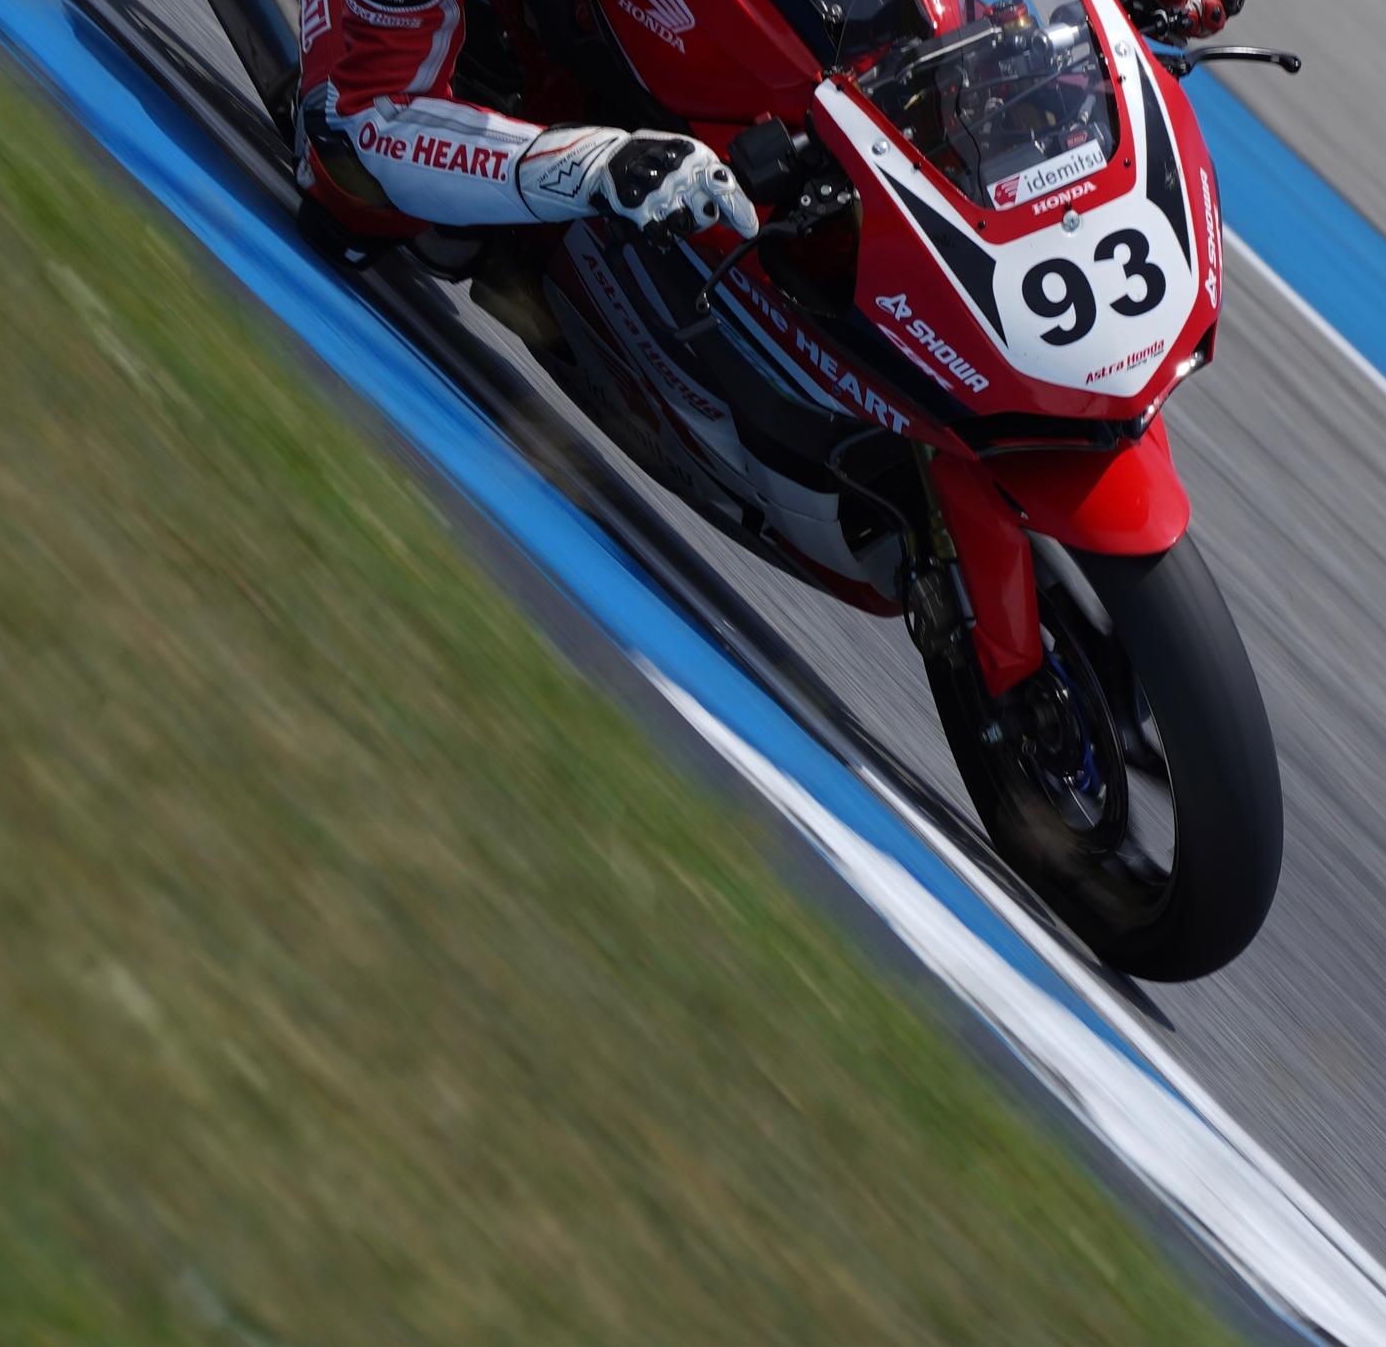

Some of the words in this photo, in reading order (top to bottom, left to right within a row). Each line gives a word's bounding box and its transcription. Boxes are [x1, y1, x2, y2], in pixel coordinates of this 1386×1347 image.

[359, 122, 407, 160] One
[411, 134, 507, 182] HEART.
[1024, 150, 1104, 193] idemitsu
[1032, 181, 1097, 215] HONDA
[1021, 228, 1167, 347] 93
[728, 265, 789, 334] One
[796, 327, 910, 435] HEART
[905, 319, 990, 394] SHOWA
[1085, 360, 1124, 385] Astra
